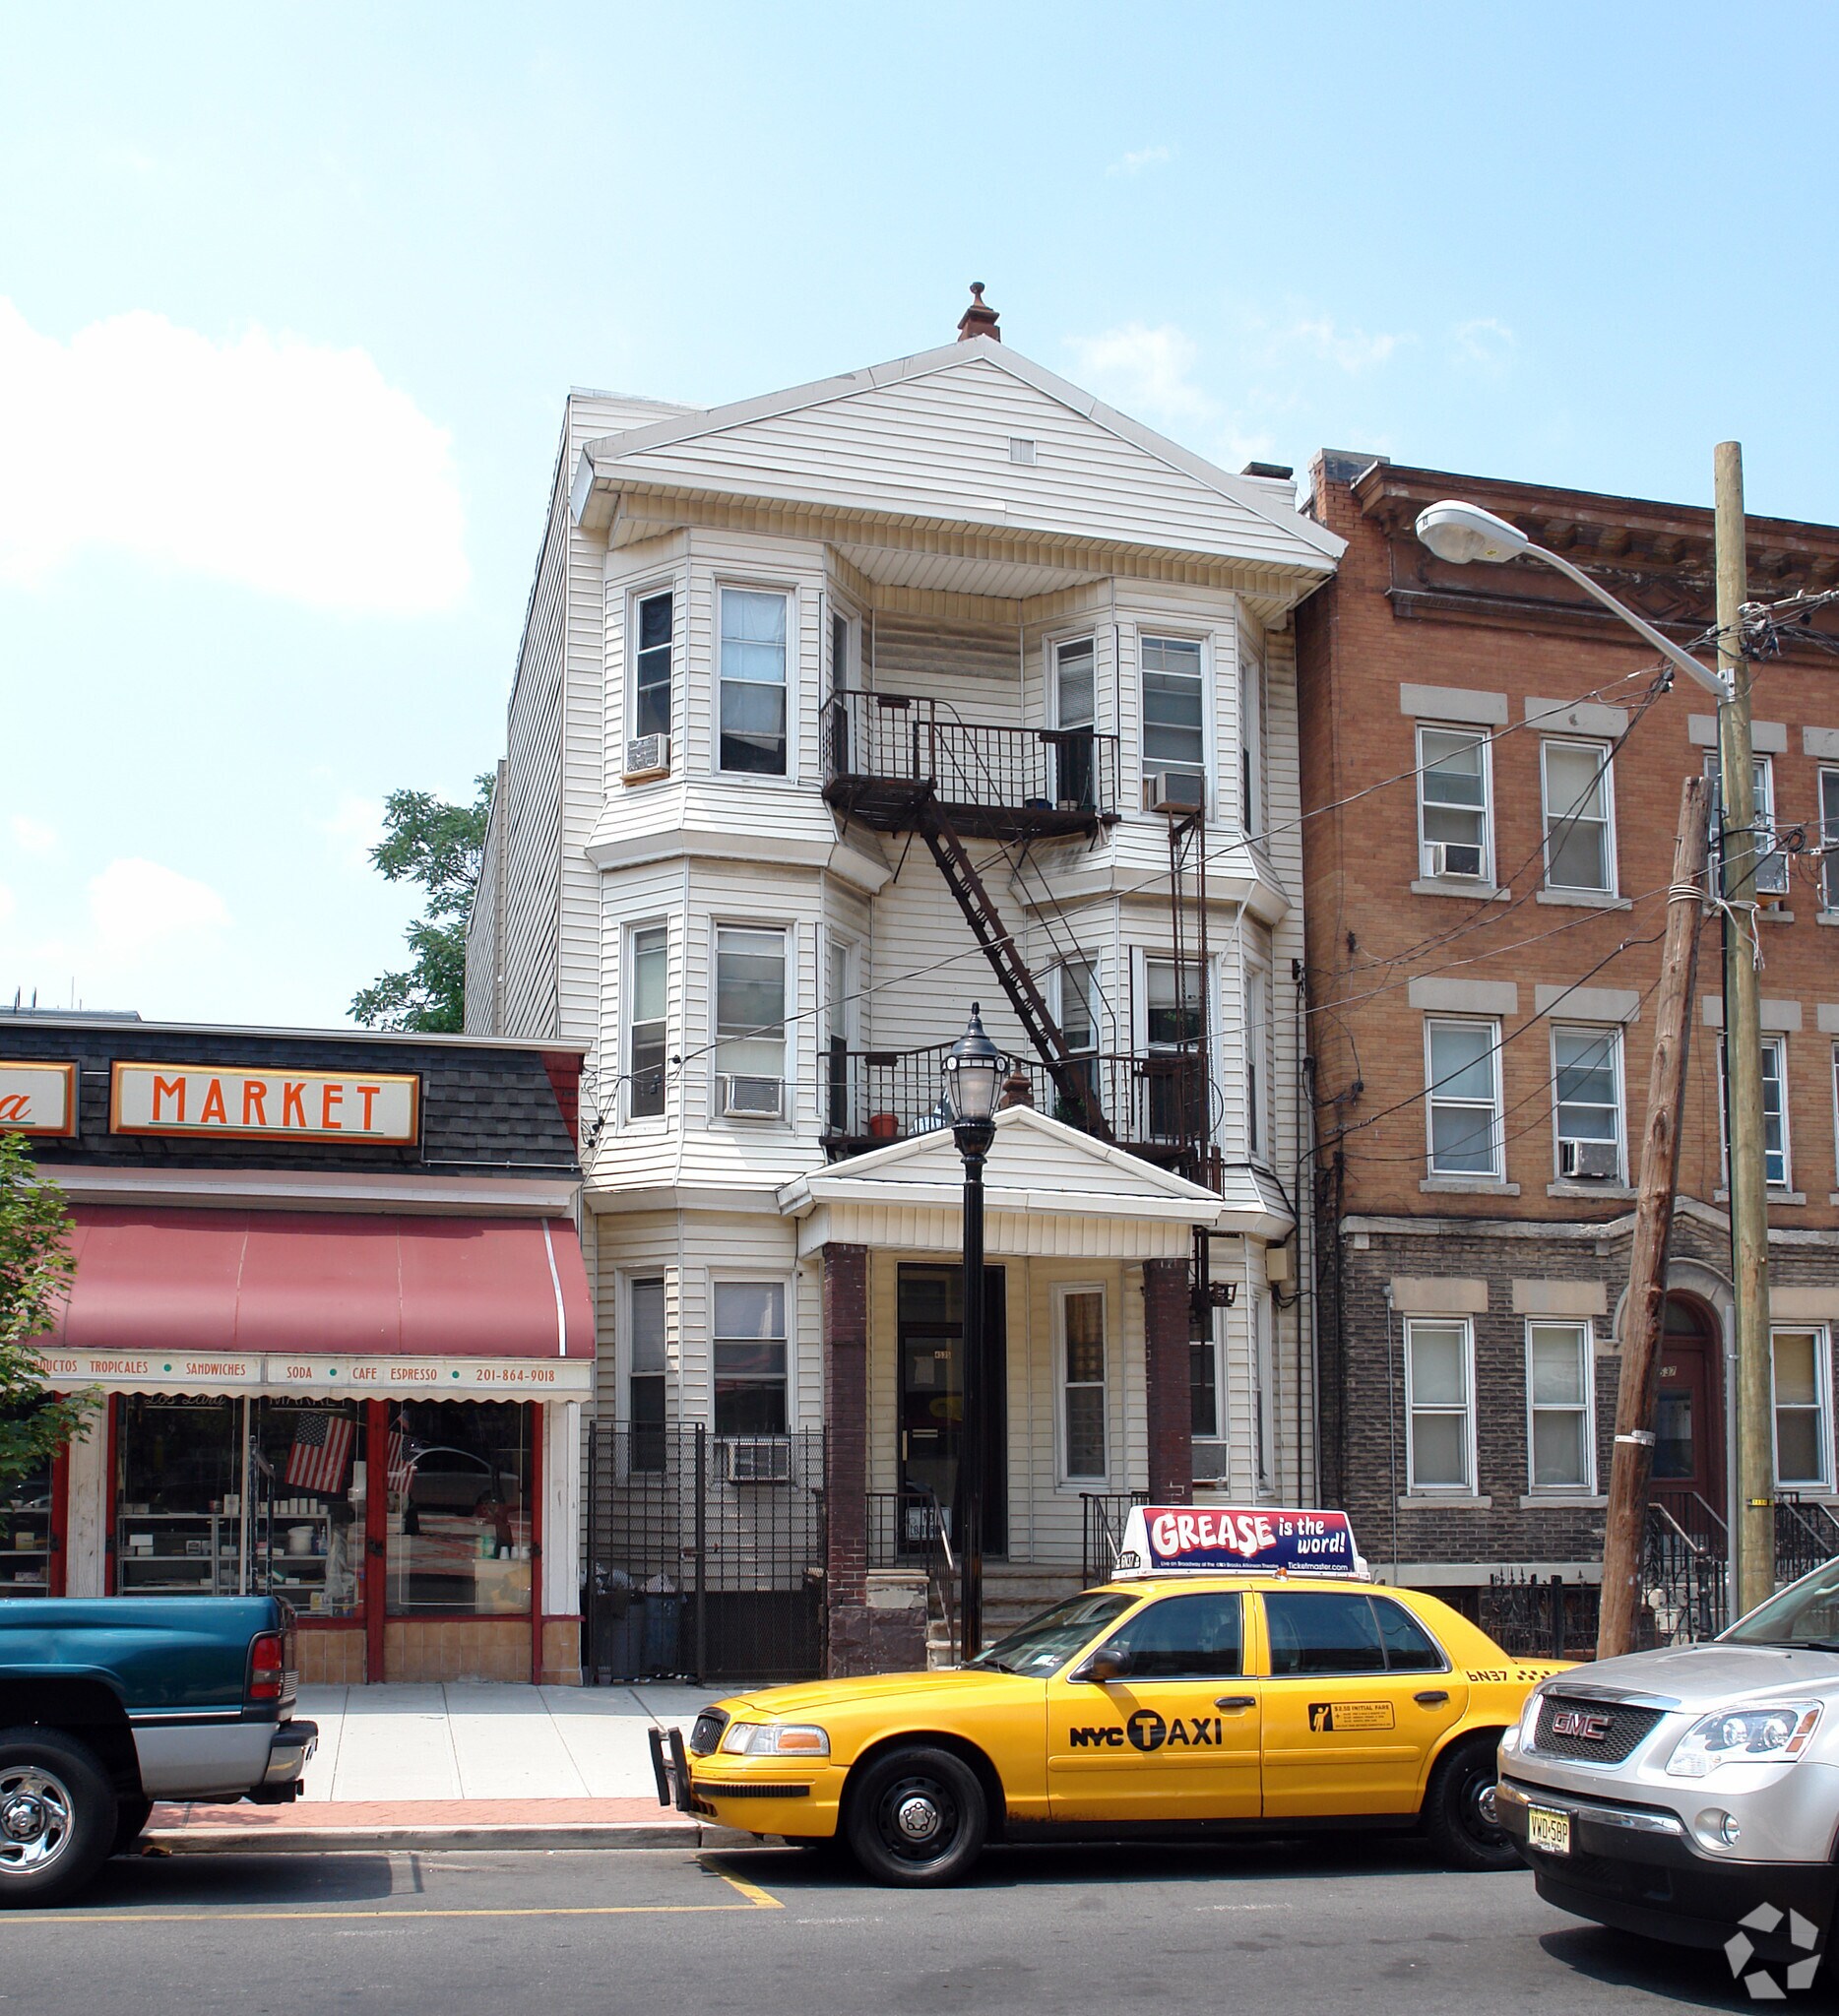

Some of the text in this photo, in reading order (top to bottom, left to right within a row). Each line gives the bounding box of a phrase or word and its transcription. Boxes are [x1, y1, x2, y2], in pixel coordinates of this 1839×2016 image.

[152, 1075, 381, 1131] MARKET
[90, 1360, 149, 1374] TROPICALES
[186, 1362, 246, 1376] SANDWICHES
[286, 1366, 313, 1379] SODA
[352, 1367, 437, 1381] CAFE ESPRESSO
[476, 1369, 555, 1382] 201-864-9018
[1153, 1514, 1277, 1555] GREASE
[1279, 1516, 1325, 1537] is the
[1297, 1531, 1346, 1554] word!
[1288, 1561, 1349, 1571] Ticketmaster.com
[1070, 1713, 1223, 1749] NYC TAXI
[1553, 1713, 1612, 1740] GMC
